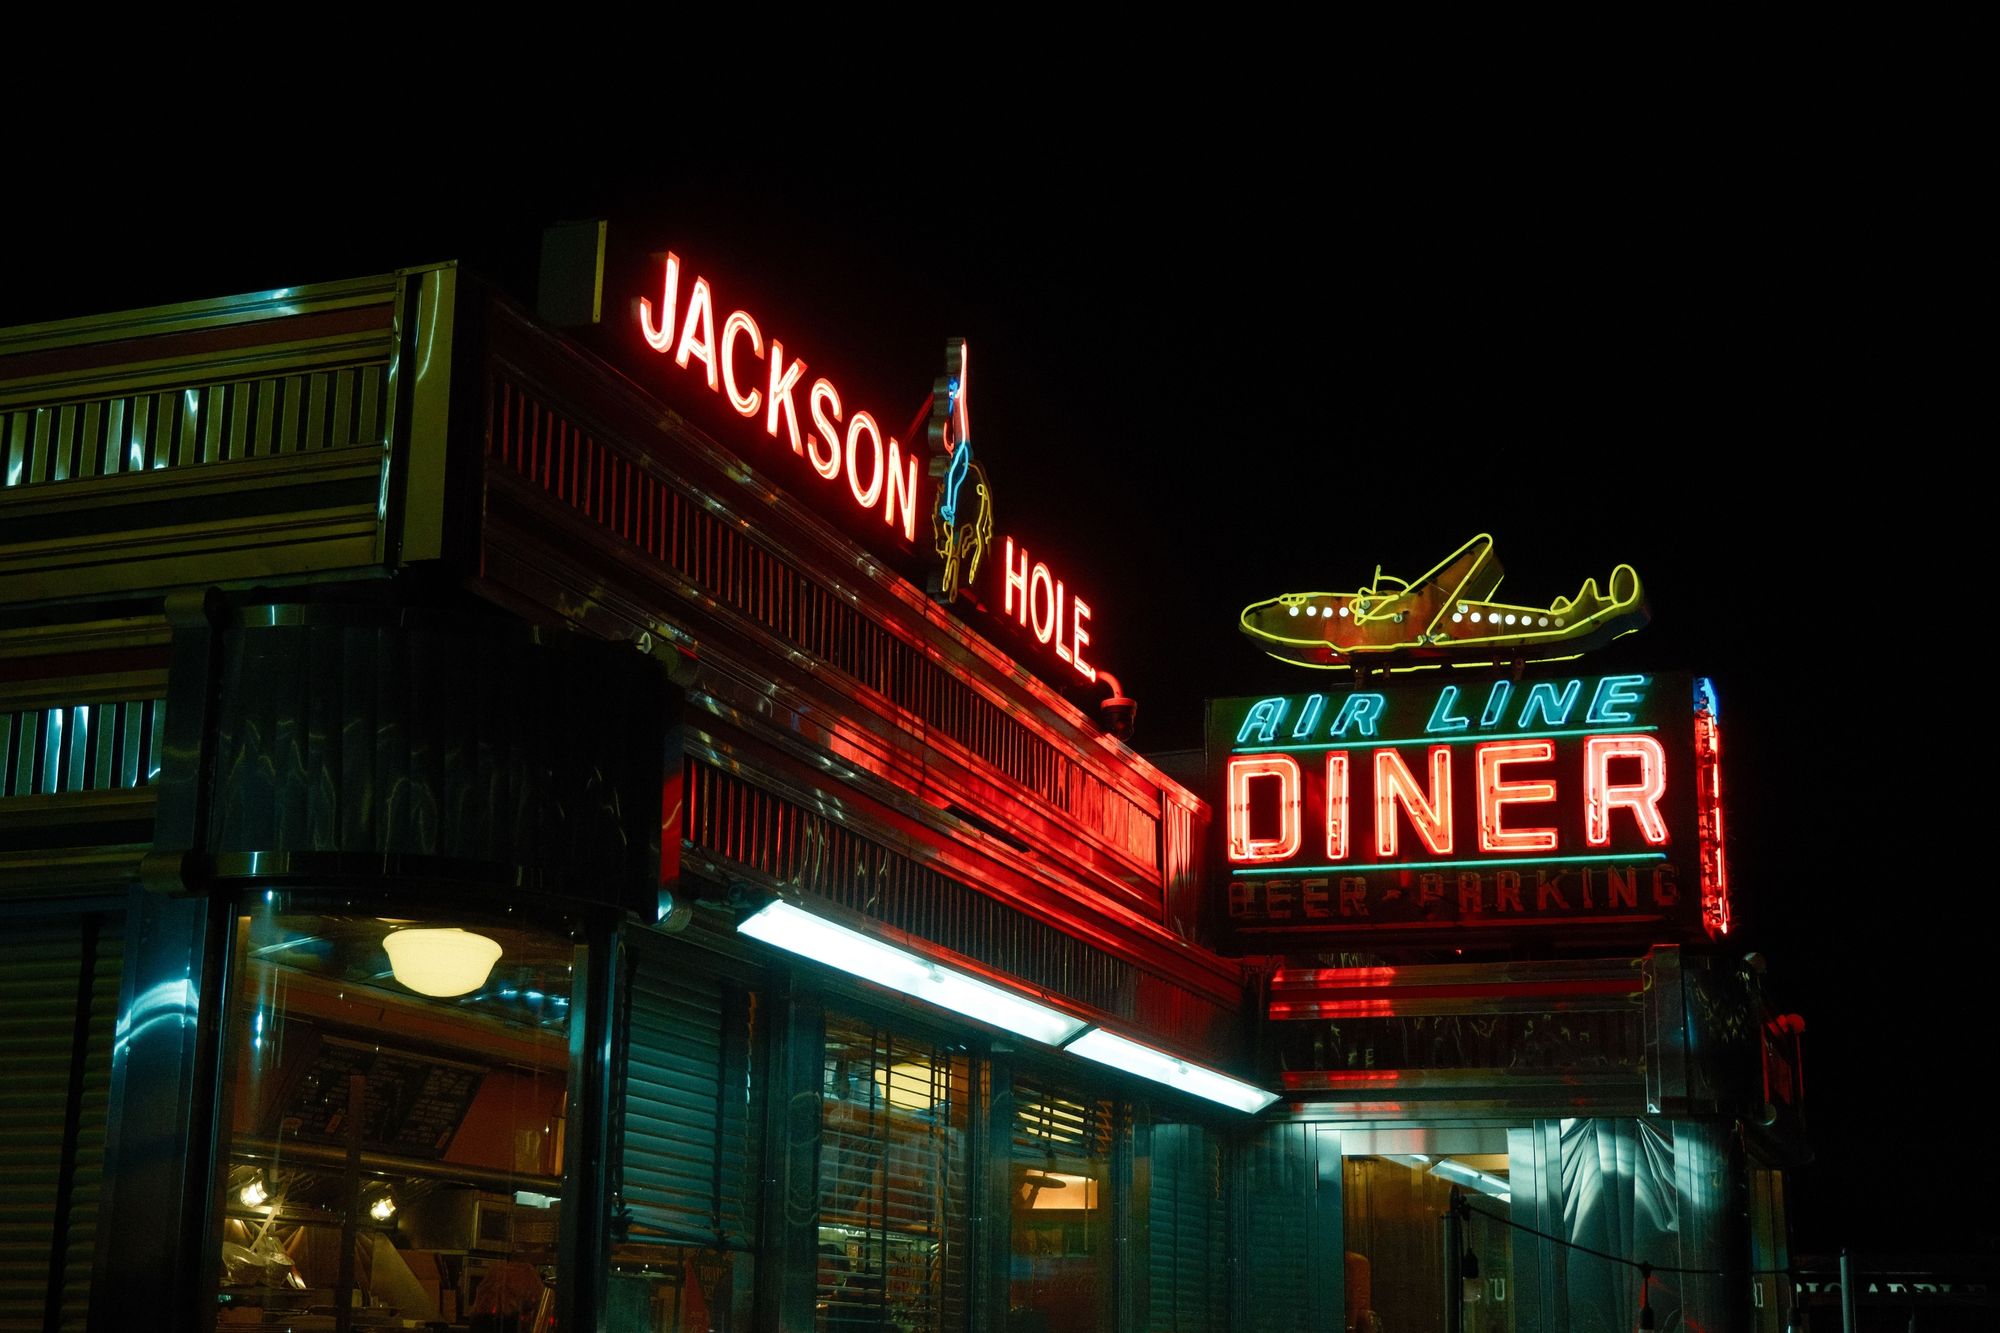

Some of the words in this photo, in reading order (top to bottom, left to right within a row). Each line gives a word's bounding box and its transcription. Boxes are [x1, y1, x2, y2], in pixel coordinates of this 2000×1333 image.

[638, 250, 918, 542] JACKSON
[1004, 535, 1097, 682] HOLE
[1236, 692, 1387, 743] AIR
[1424, 674, 1653, 734] LINE
[1226, 734, 1669, 865] DINER
[1416, 862, 1682, 916] PARKING
